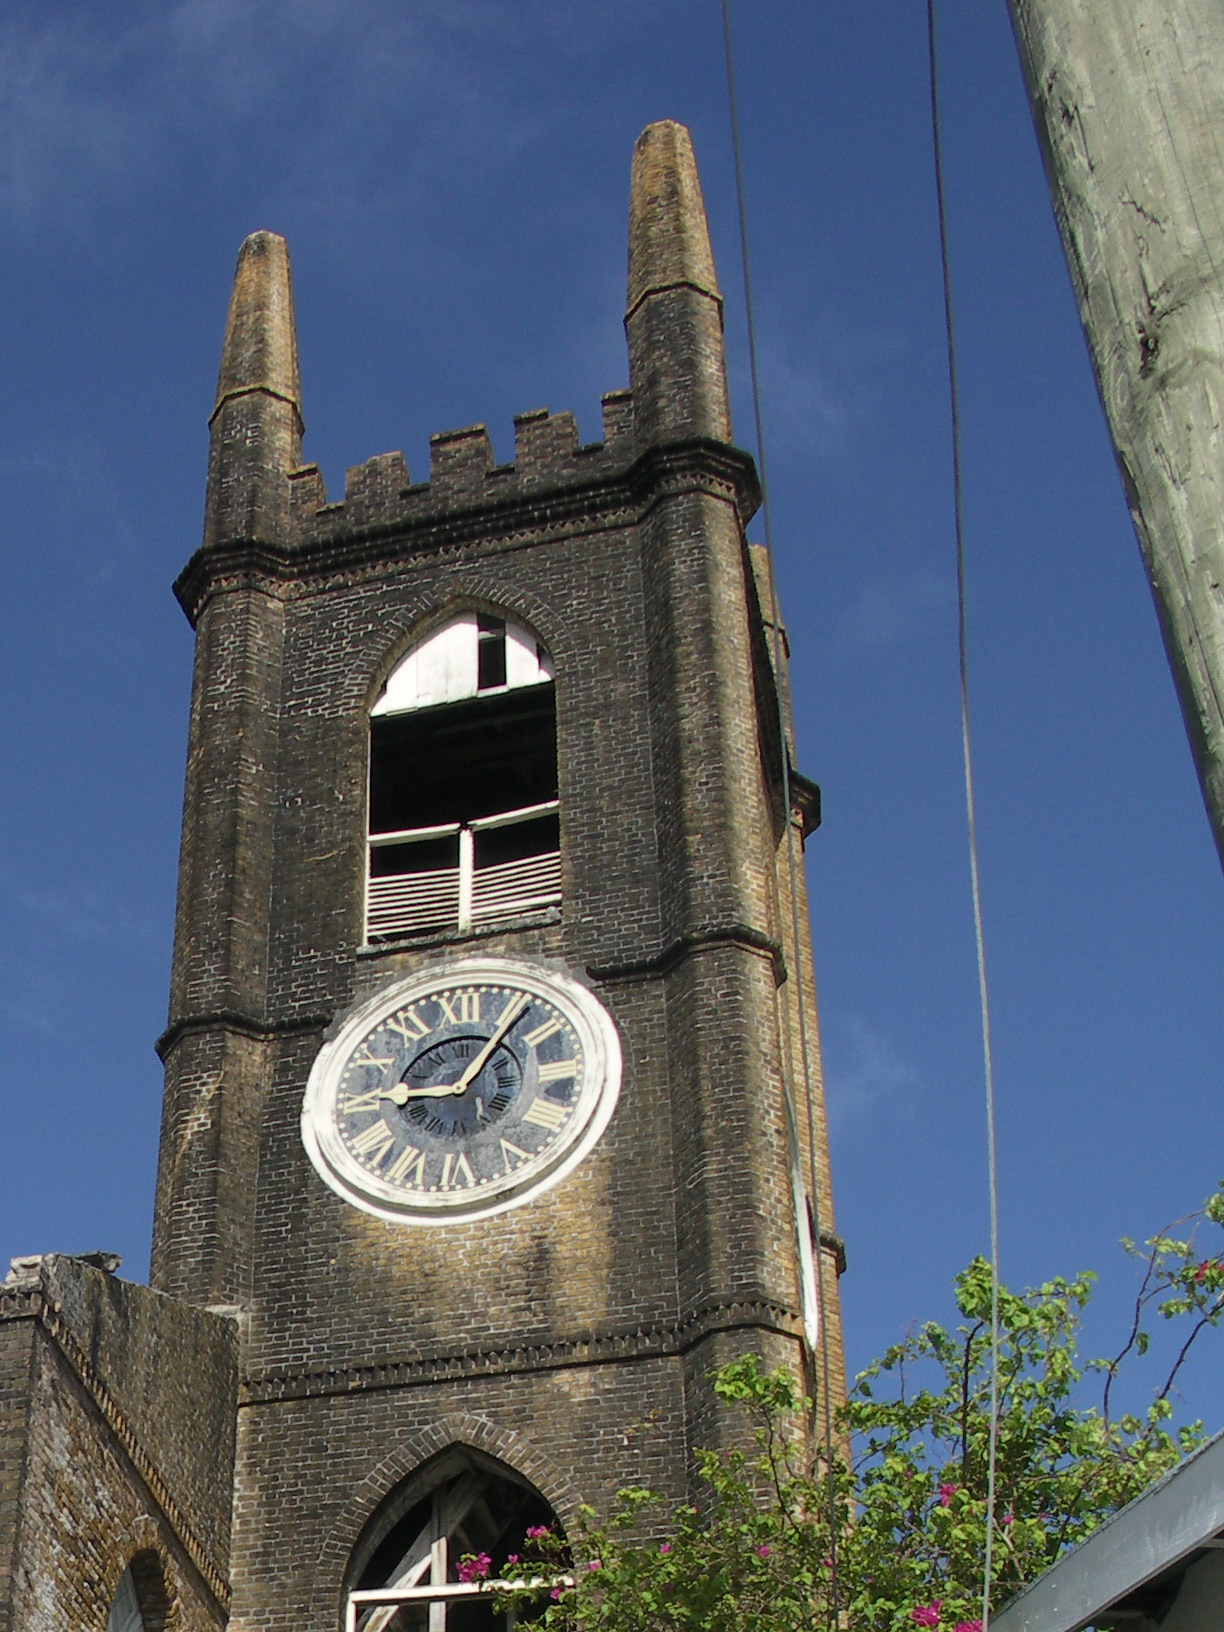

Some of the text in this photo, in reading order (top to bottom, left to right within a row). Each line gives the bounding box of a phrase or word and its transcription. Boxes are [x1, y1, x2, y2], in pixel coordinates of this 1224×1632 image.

[387, 1007, 433, 1047] XI
[438, 992, 481, 1027] XII
[523, 1017, 564, 1049] II
[357, 1049, 396, 1074] X
[538, 1058, 578, 1083] III
[522, 1098, 569, 1131] IIII
[352, 1118, 397, 1168] VIII
[500, 1138, 536, 1173] V
[386, 1144, 426, 1186] VII
[439, 1152, 476, 1187] VI
